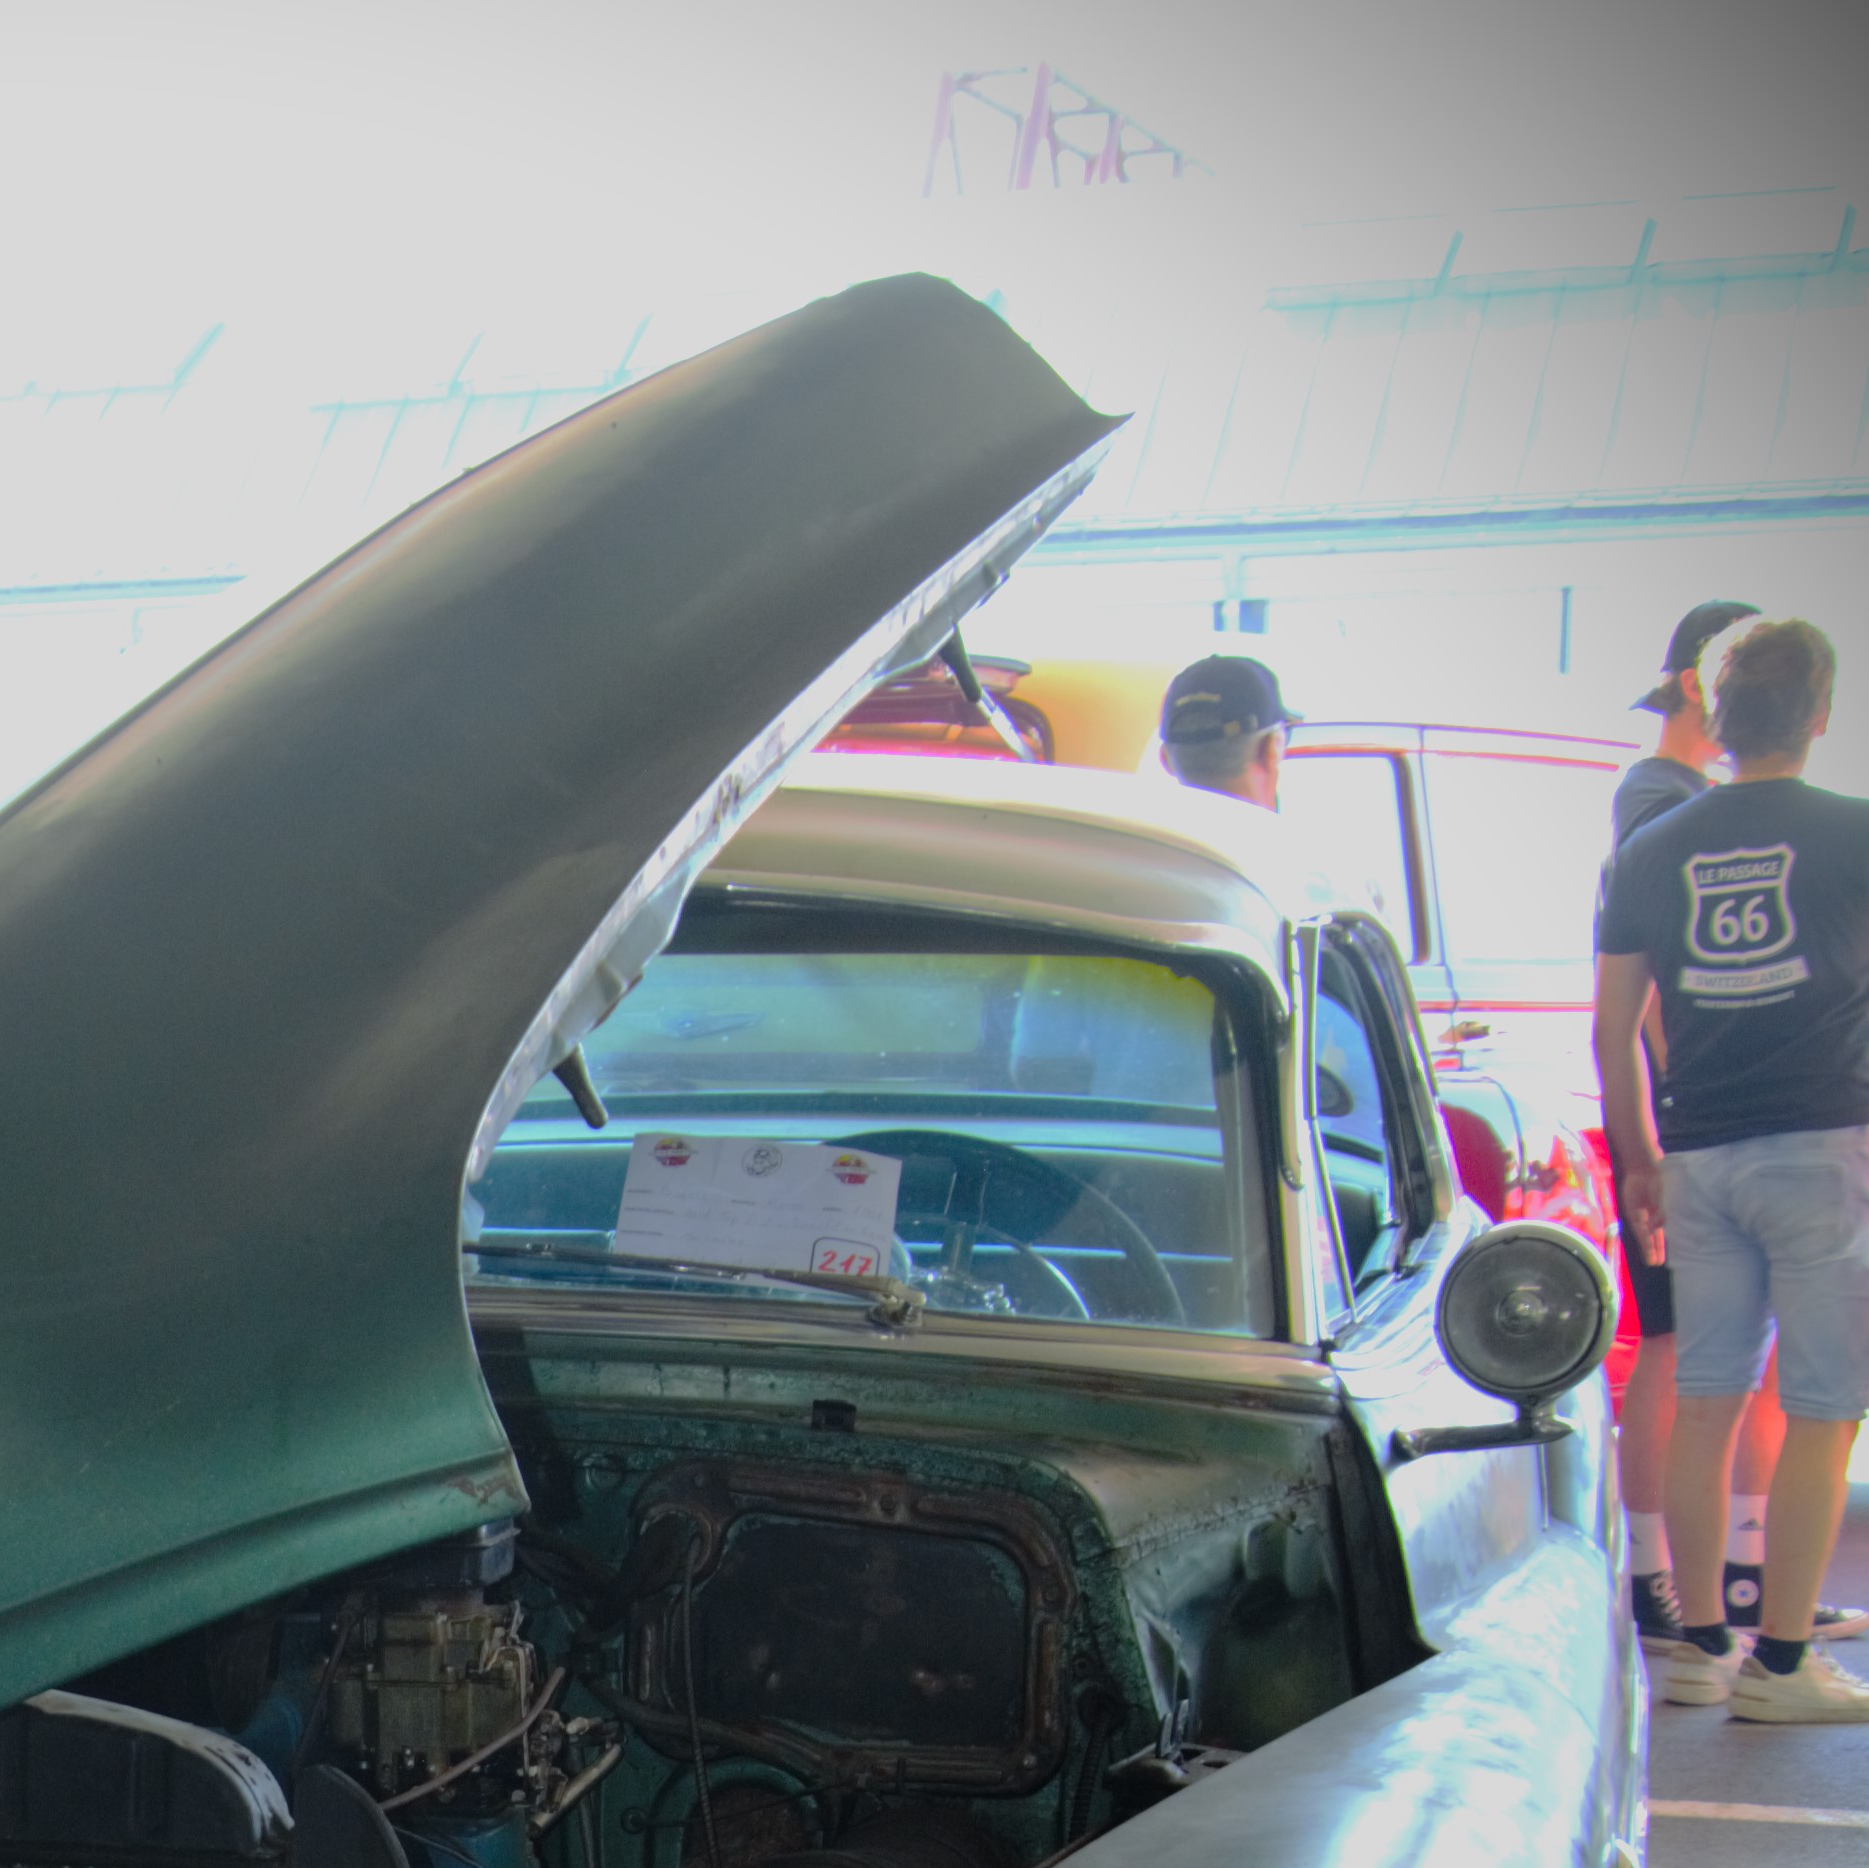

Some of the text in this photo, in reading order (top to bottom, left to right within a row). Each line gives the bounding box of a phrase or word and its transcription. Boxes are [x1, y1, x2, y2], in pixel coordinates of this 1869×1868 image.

[1698, 861, 1780, 884] LE PASSAGE
[1709, 894, 1770, 945] 66
[1694, 966, 1794, 989] SWITZERLAND
